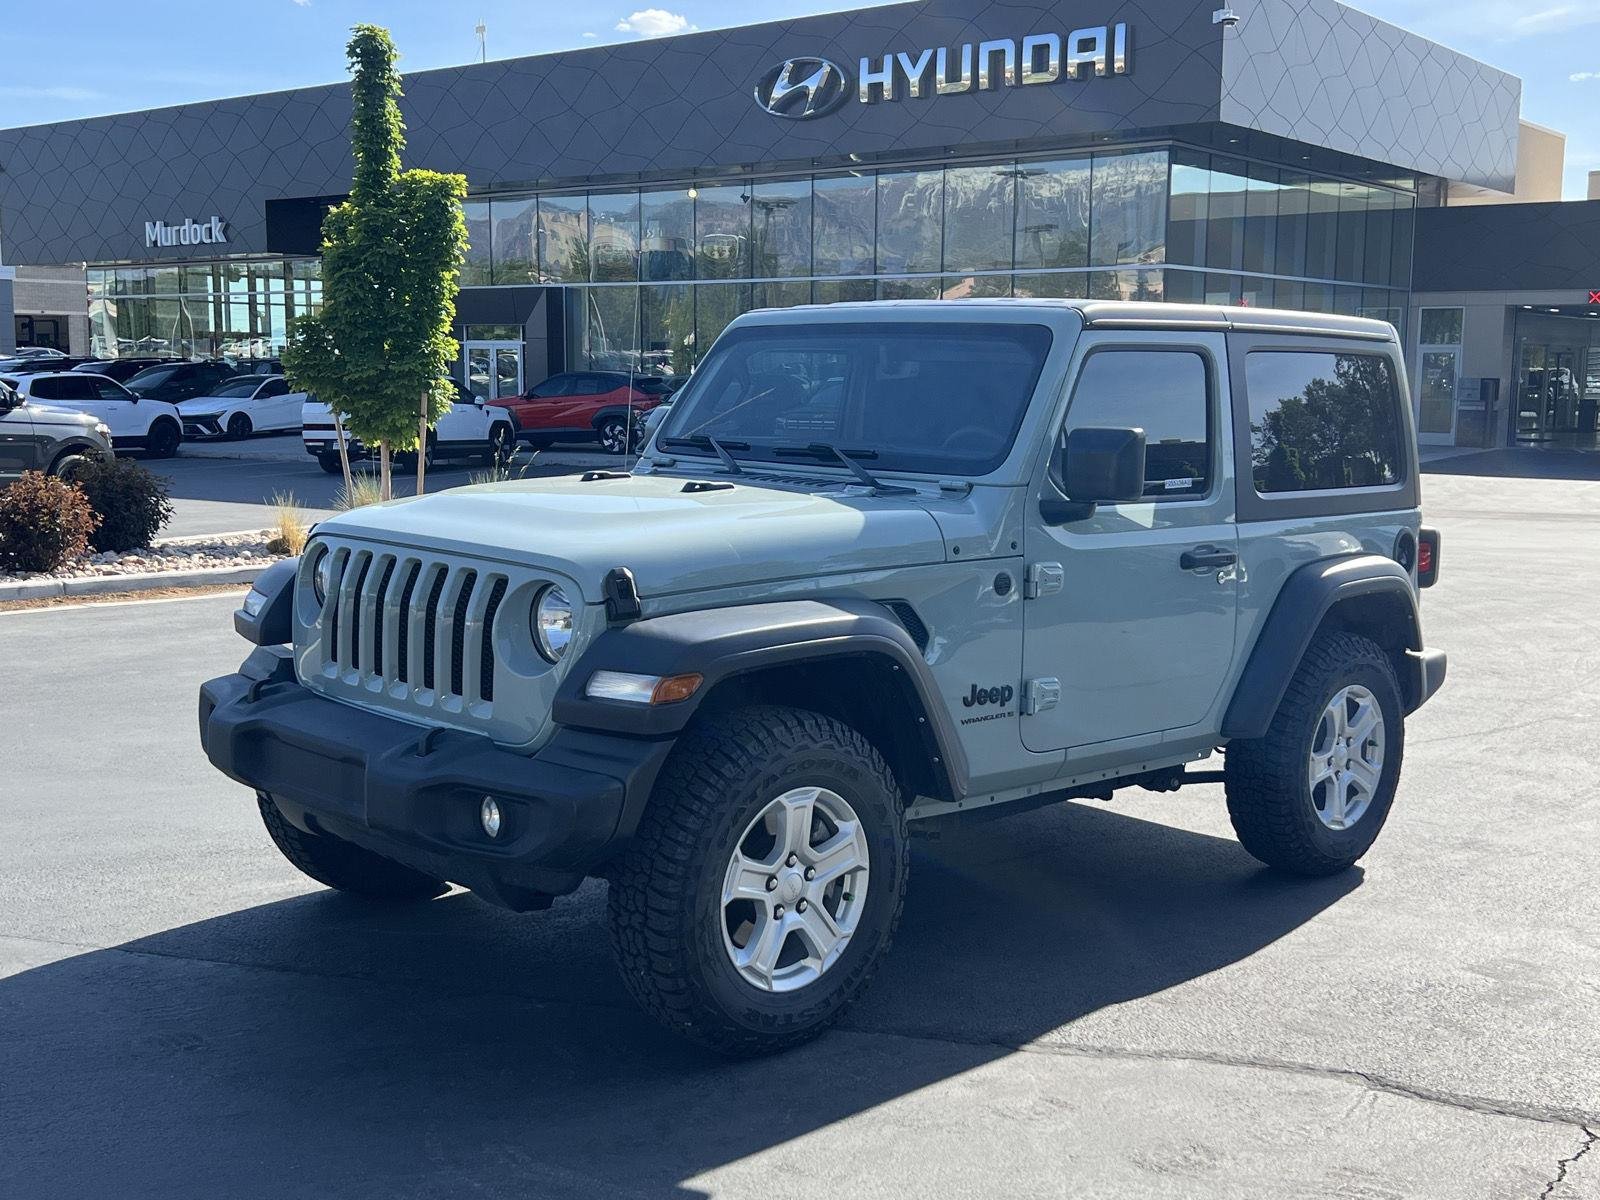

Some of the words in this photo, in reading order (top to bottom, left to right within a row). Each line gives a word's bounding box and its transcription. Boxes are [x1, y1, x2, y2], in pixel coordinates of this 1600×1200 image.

[859, 22, 1127, 103] HYUNDAI
[145, 216, 228, 247] Murdock
[962, 683, 1014, 707] Jeep
[960, 712, 1006, 725] WRANGLER
